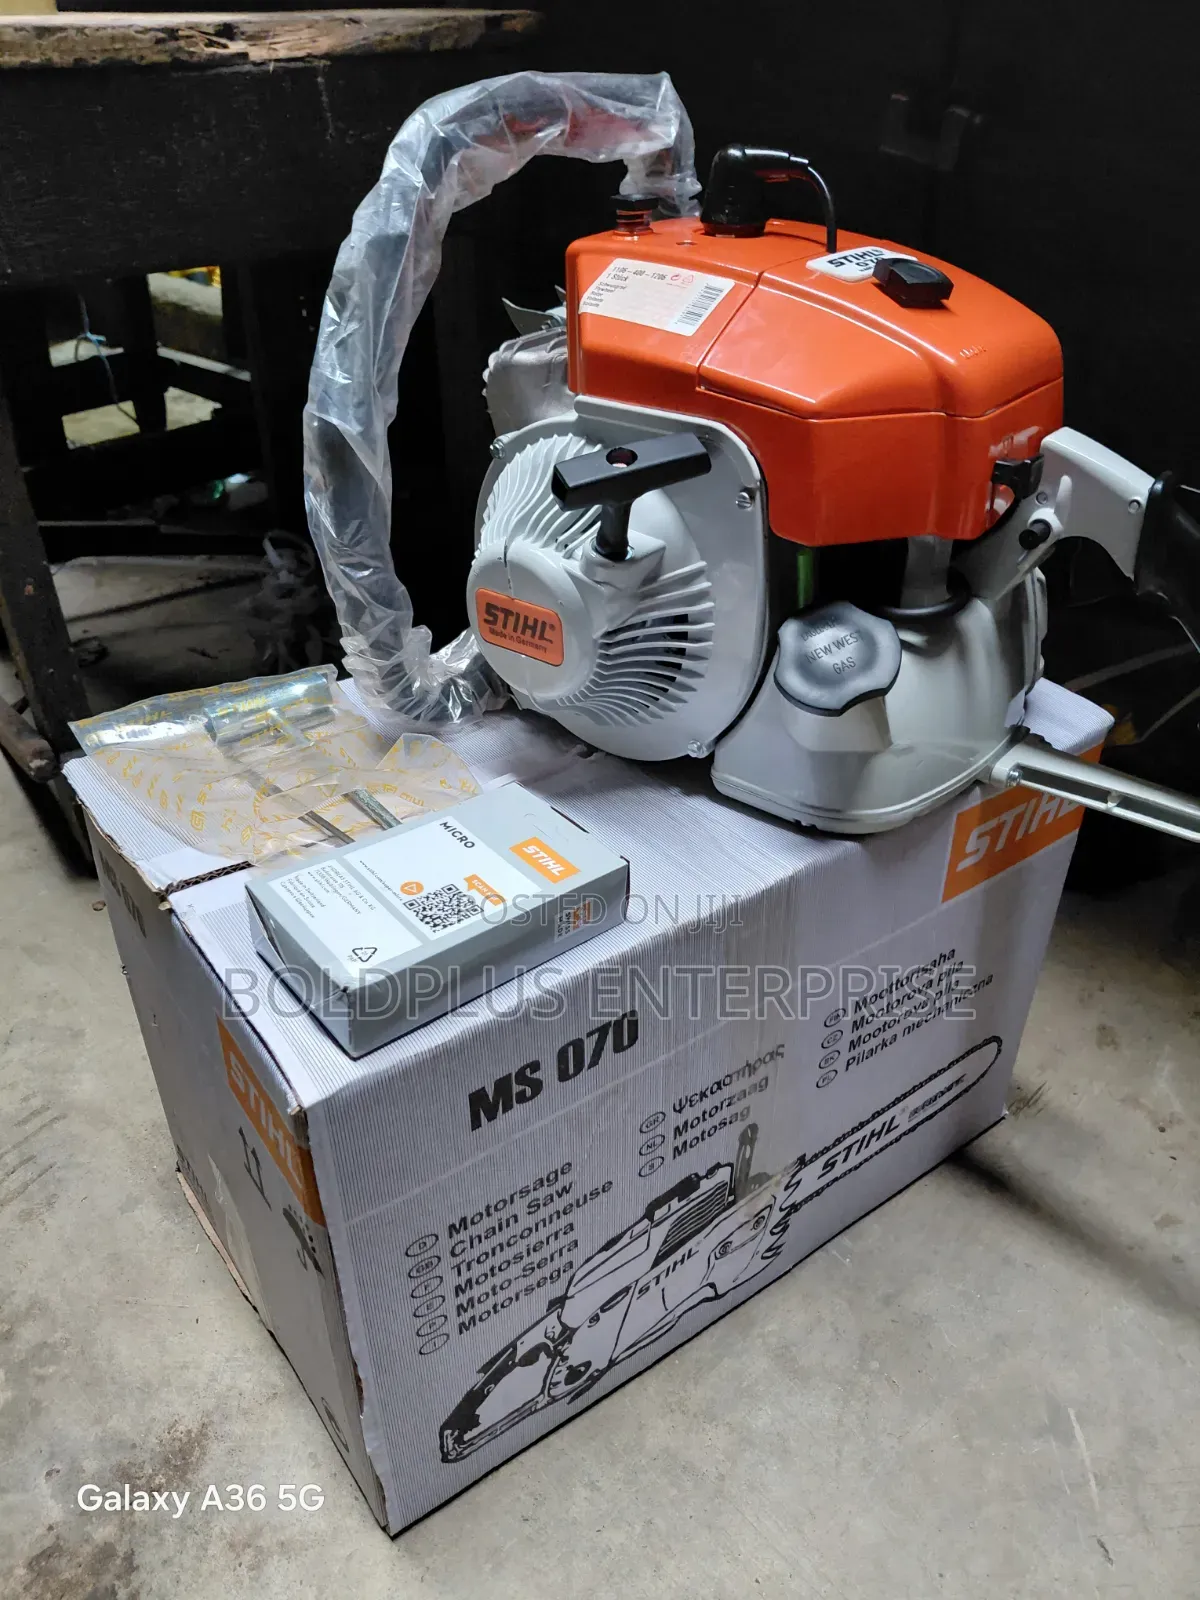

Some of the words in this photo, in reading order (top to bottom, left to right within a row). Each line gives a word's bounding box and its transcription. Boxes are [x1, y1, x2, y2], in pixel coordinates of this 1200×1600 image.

[827, 249, 884, 268] STIHL
[483, 602, 554, 645] STIHL
[489, 626, 507, 639] Made
[508, 634, 515, 643] in
[516, 636, 548, 654] Germany
[805, 644, 833, 664] NEW
[832, 630, 864, 651] WEST
[832, 656, 857, 675] GAS
[440, 821, 475, 849] MICRO
[522, 845, 566, 876] STIHL
[851, 979, 933, 1034] Mootorova
[854, 948, 956, 1014] Moottorisaha
[845, 1034, 898, 1072] Pilarka
[903, 973, 994, 1037] mechaniczna
[467, 1059, 544, 1133] MS
[557, 1009, 639, 1083] 070
[229, 1051, 303, 1190] STIHL
[672, 1105, 750, 1160] Motosag
[673, 1076, 769, 1140] Motorzaag
[817, 1115, 900, 1180] STIHL
[448, 1161, 573, 1238] Motorsage
[450, 1213, 519, 1258] Chain
[526, 1181, 573, 1216] Saw
[451, 1180, 614, 1276] Tronconneuse
[454, 1221, 575, 1299] Motosierra
[456, 1238, 579, 1318] Moto-Serra
[636, 1247, 699, 1300] STIHL
[458, 1260, 574, 1336] Motorsega
